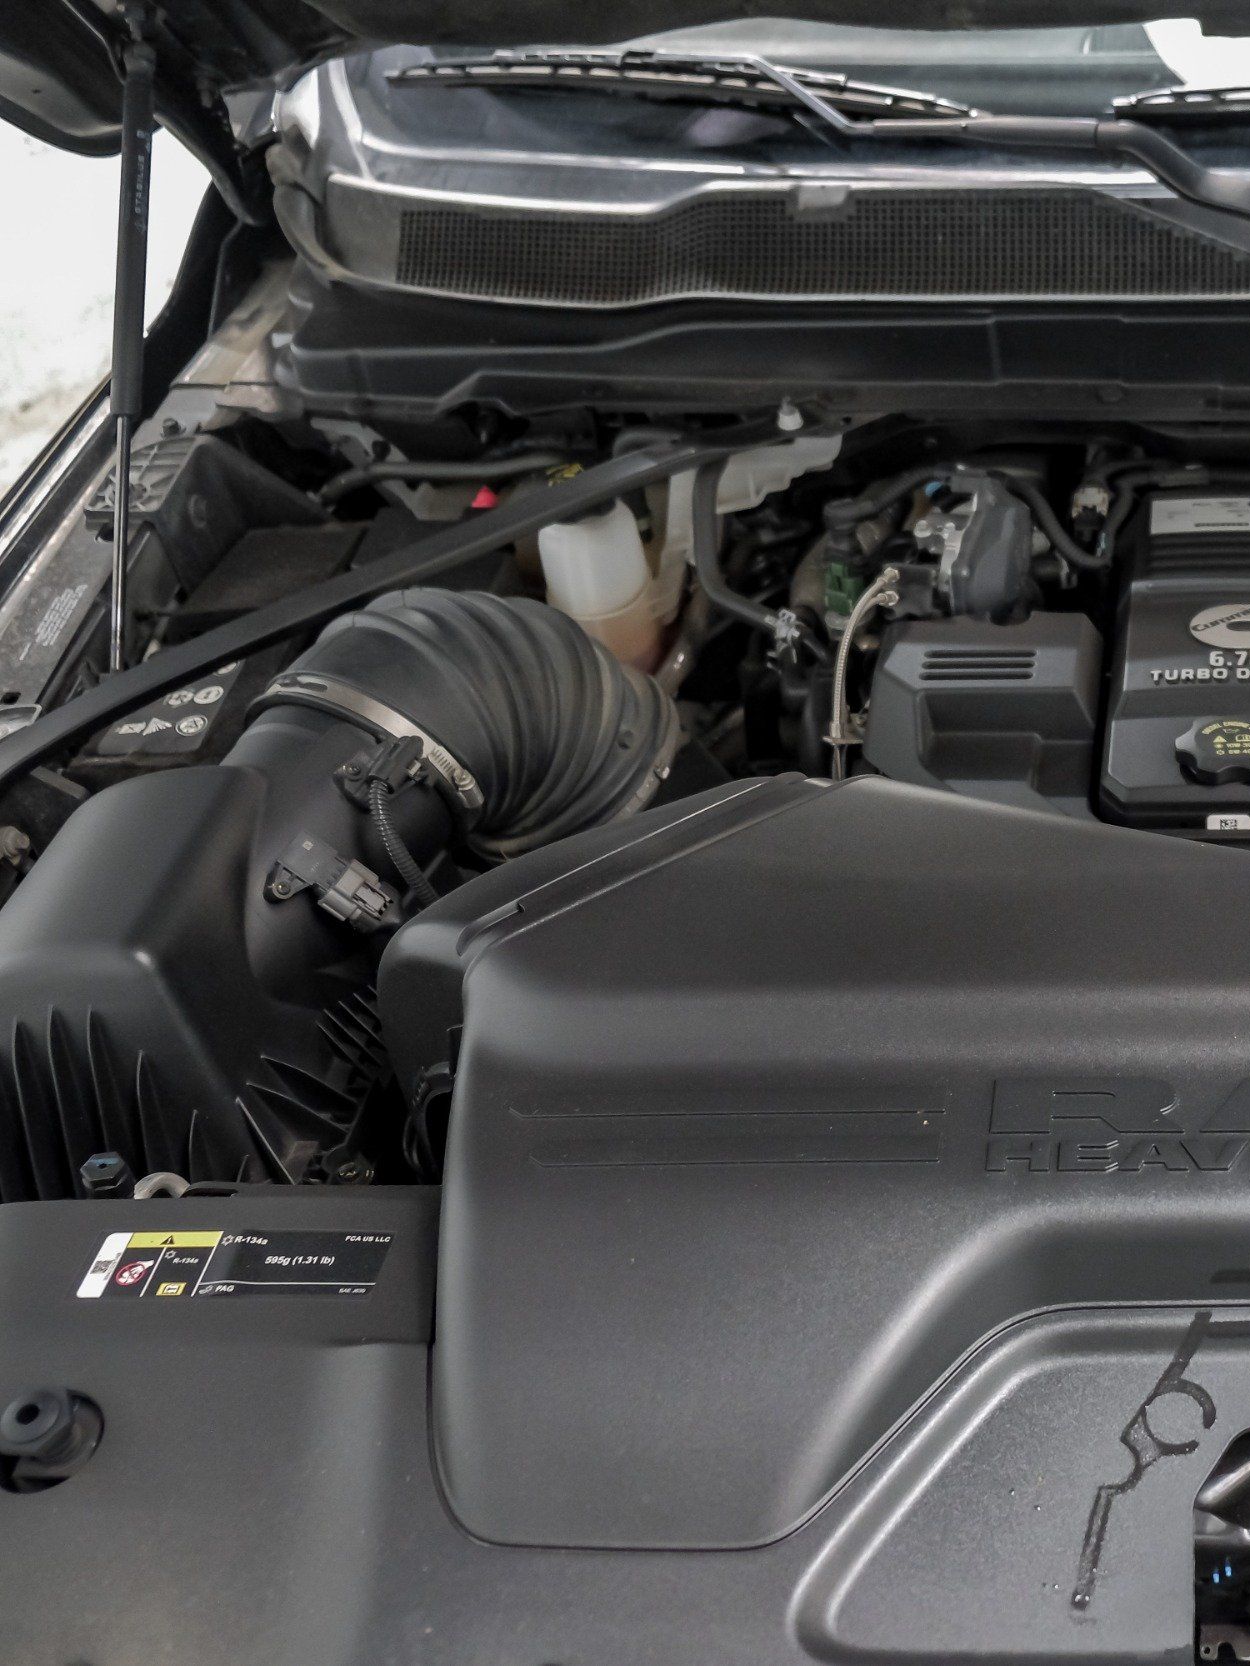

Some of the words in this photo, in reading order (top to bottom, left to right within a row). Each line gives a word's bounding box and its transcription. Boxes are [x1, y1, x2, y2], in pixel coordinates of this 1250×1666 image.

[1150, 668, 1228, 682] TURBO
[234, 1236, 268, 1245] R-134a
[264, 1256, 291, 1266] 595g
[292, 1256, 318, 1265] (1.31
[320, 1256, 335, 1266] lb)
